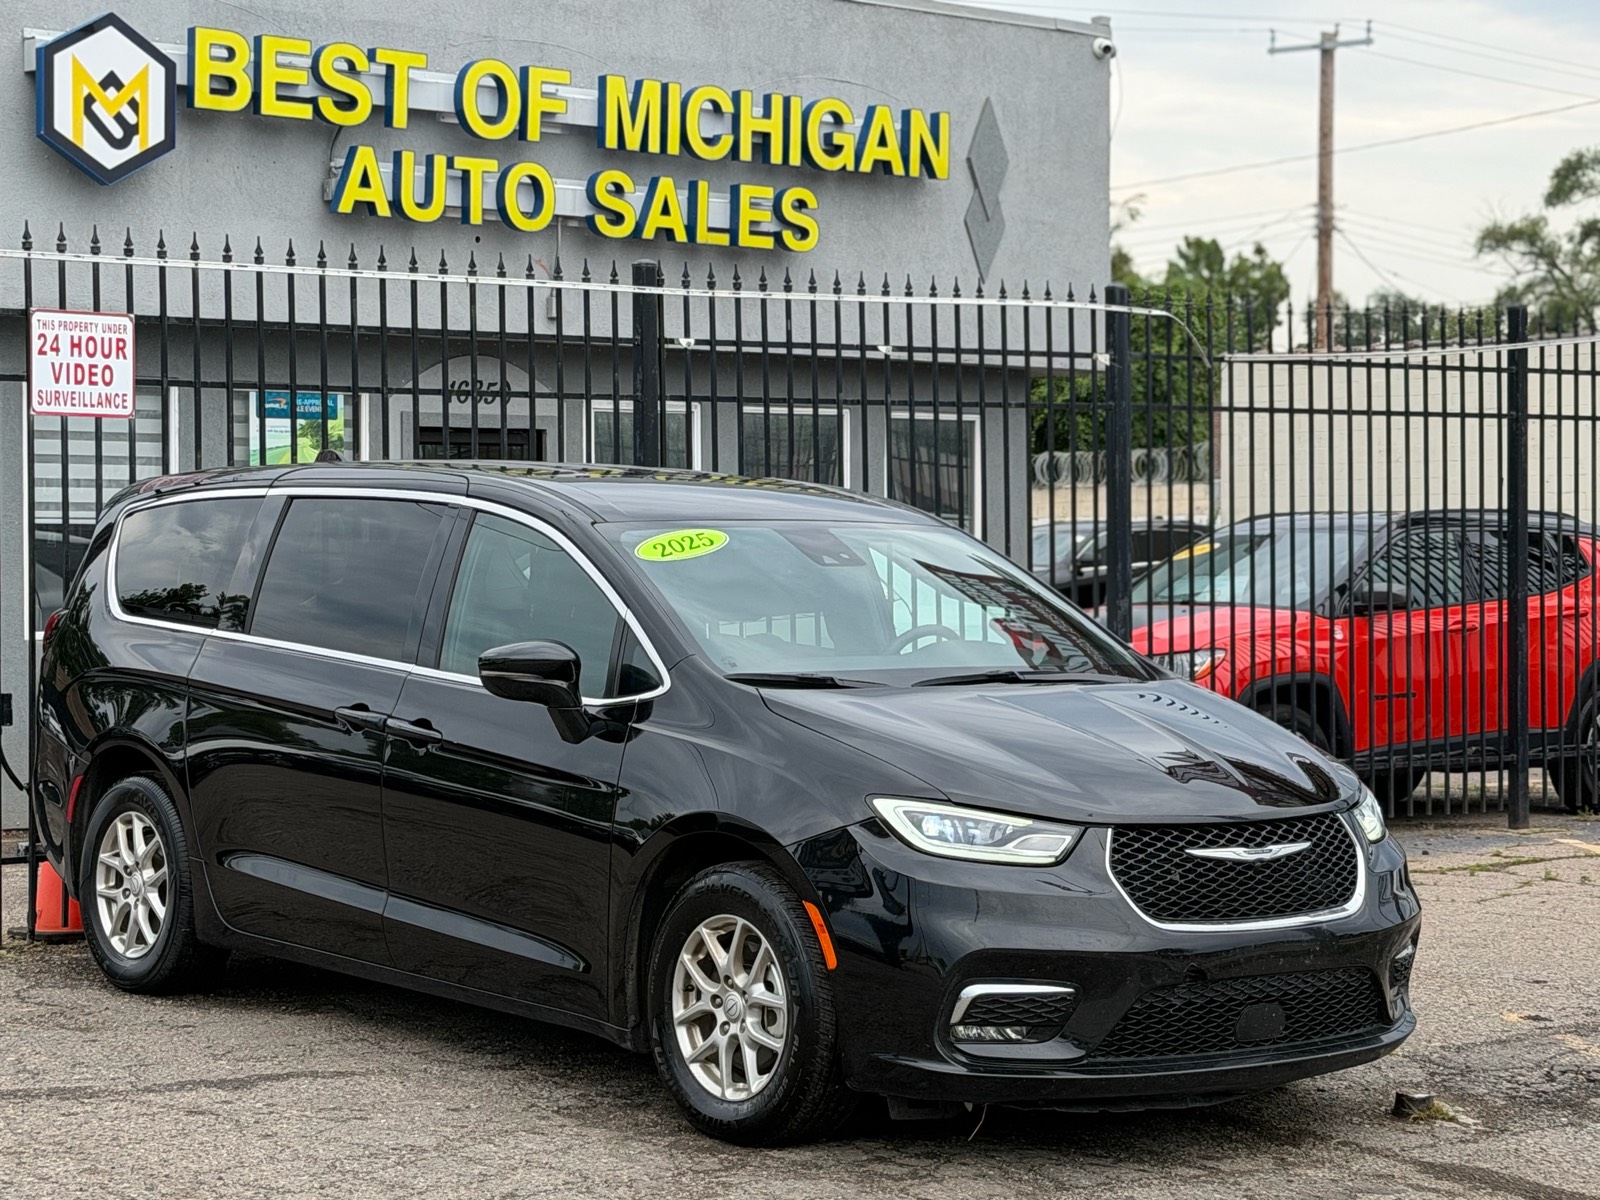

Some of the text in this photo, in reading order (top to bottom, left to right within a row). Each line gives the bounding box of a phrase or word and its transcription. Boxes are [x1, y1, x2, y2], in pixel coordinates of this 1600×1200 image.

[187, 26, 950, 181] BEST OF MICHIGAN
[330, 145, 820, 253] AUTO SALES
[36, 319, 128, 335] THIS PROPERTY UNDER
[37, 332, 128, 360] 24 HOUR
[50, 361, 114, 387] VIDEO
[36, 388, 128, 410] SURVEILLANCE
[652, 532, 715, 558] 2025
